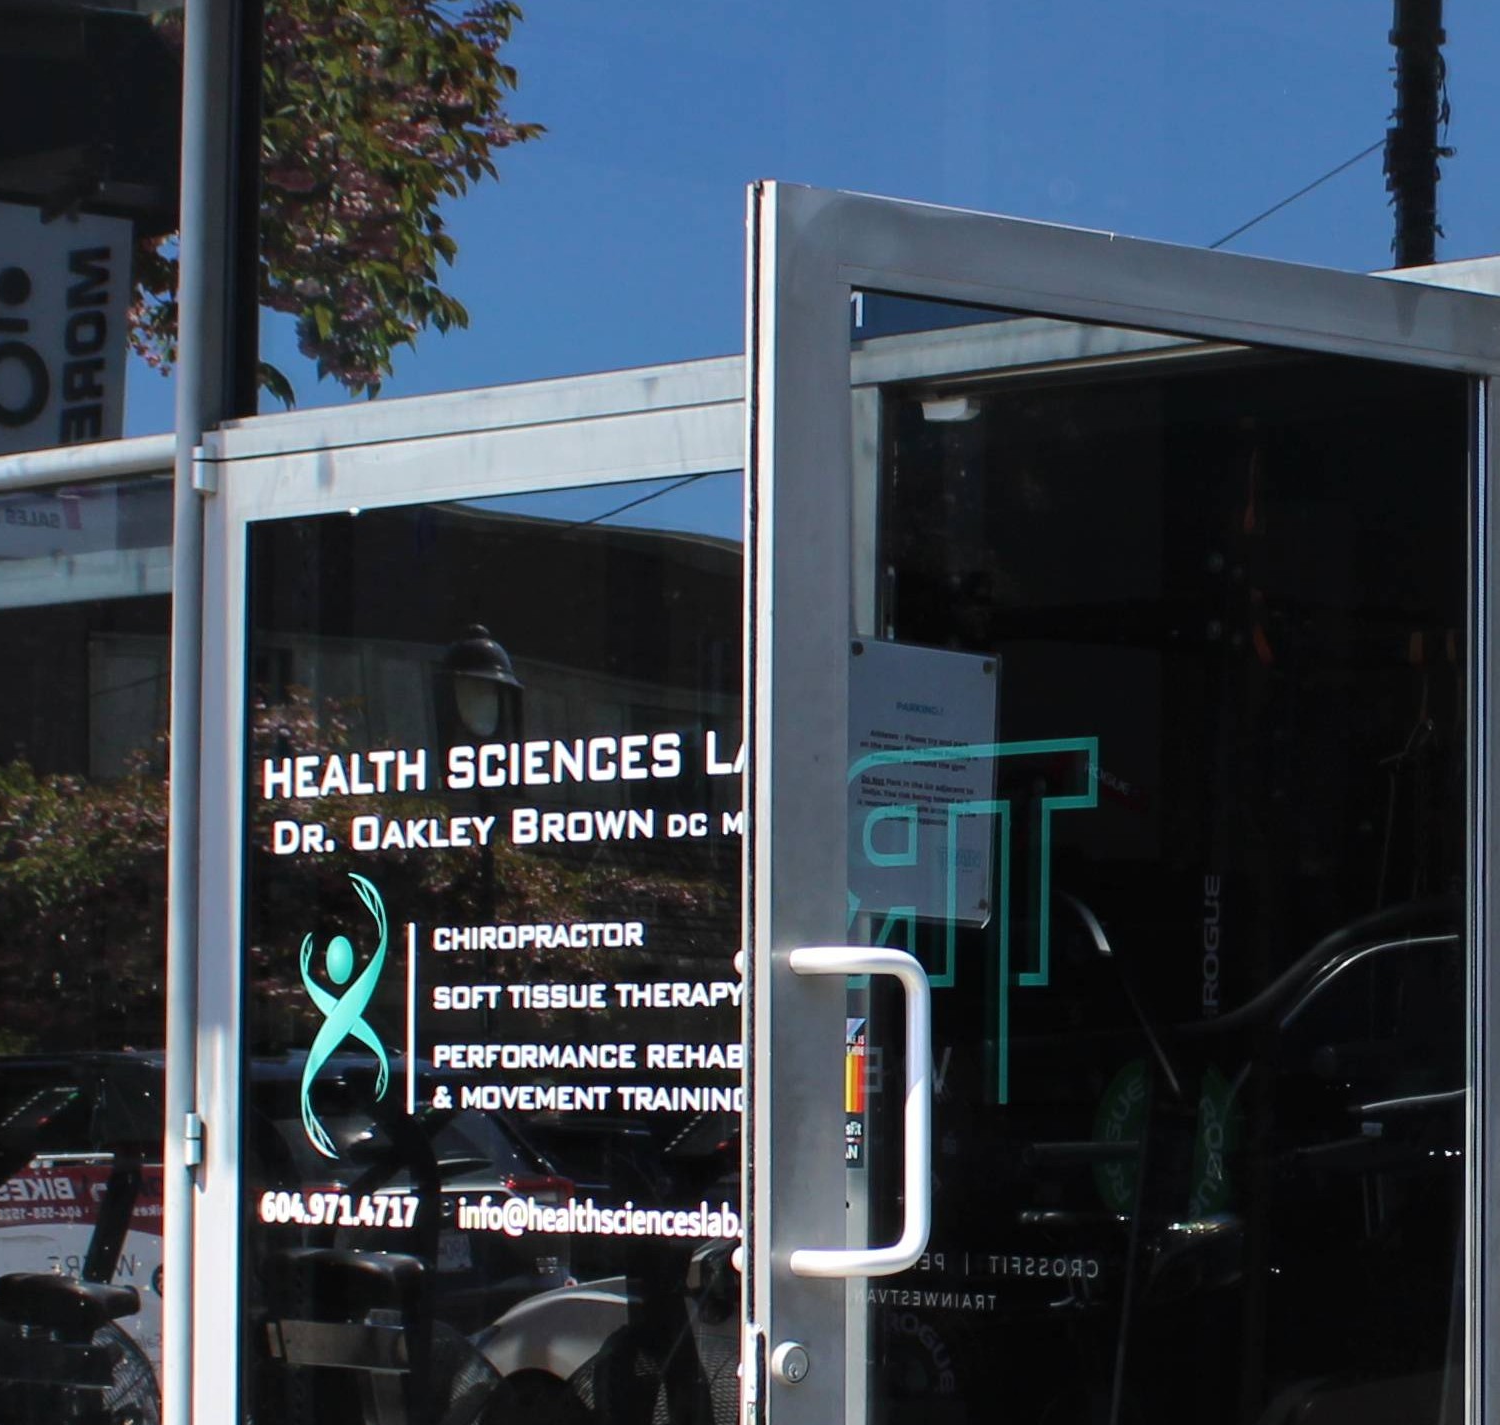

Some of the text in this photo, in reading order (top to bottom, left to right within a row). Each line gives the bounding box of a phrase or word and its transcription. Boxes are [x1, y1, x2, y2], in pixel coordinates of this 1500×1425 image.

[261, 750, 426, 801] HEALTH
[447, 732, 681, 790] SCIENCES
[667, 813, 707, 837] DC
[433, 922, 644, 951] CHIROPRACTOR
[1202, 874, 1222, 1009] ROGUE
[433, 983, 743, 1010] SOFT TISSUE THERAPY
[433, 1044, 636, 1071] PERFORMANCE
[433, 1087, 452, 1111] &
[460, 1086, 608, 1111] MOVEMENT
[260, 1192, 744, 1240] 604.971.4717 info@healthscienceslab.
